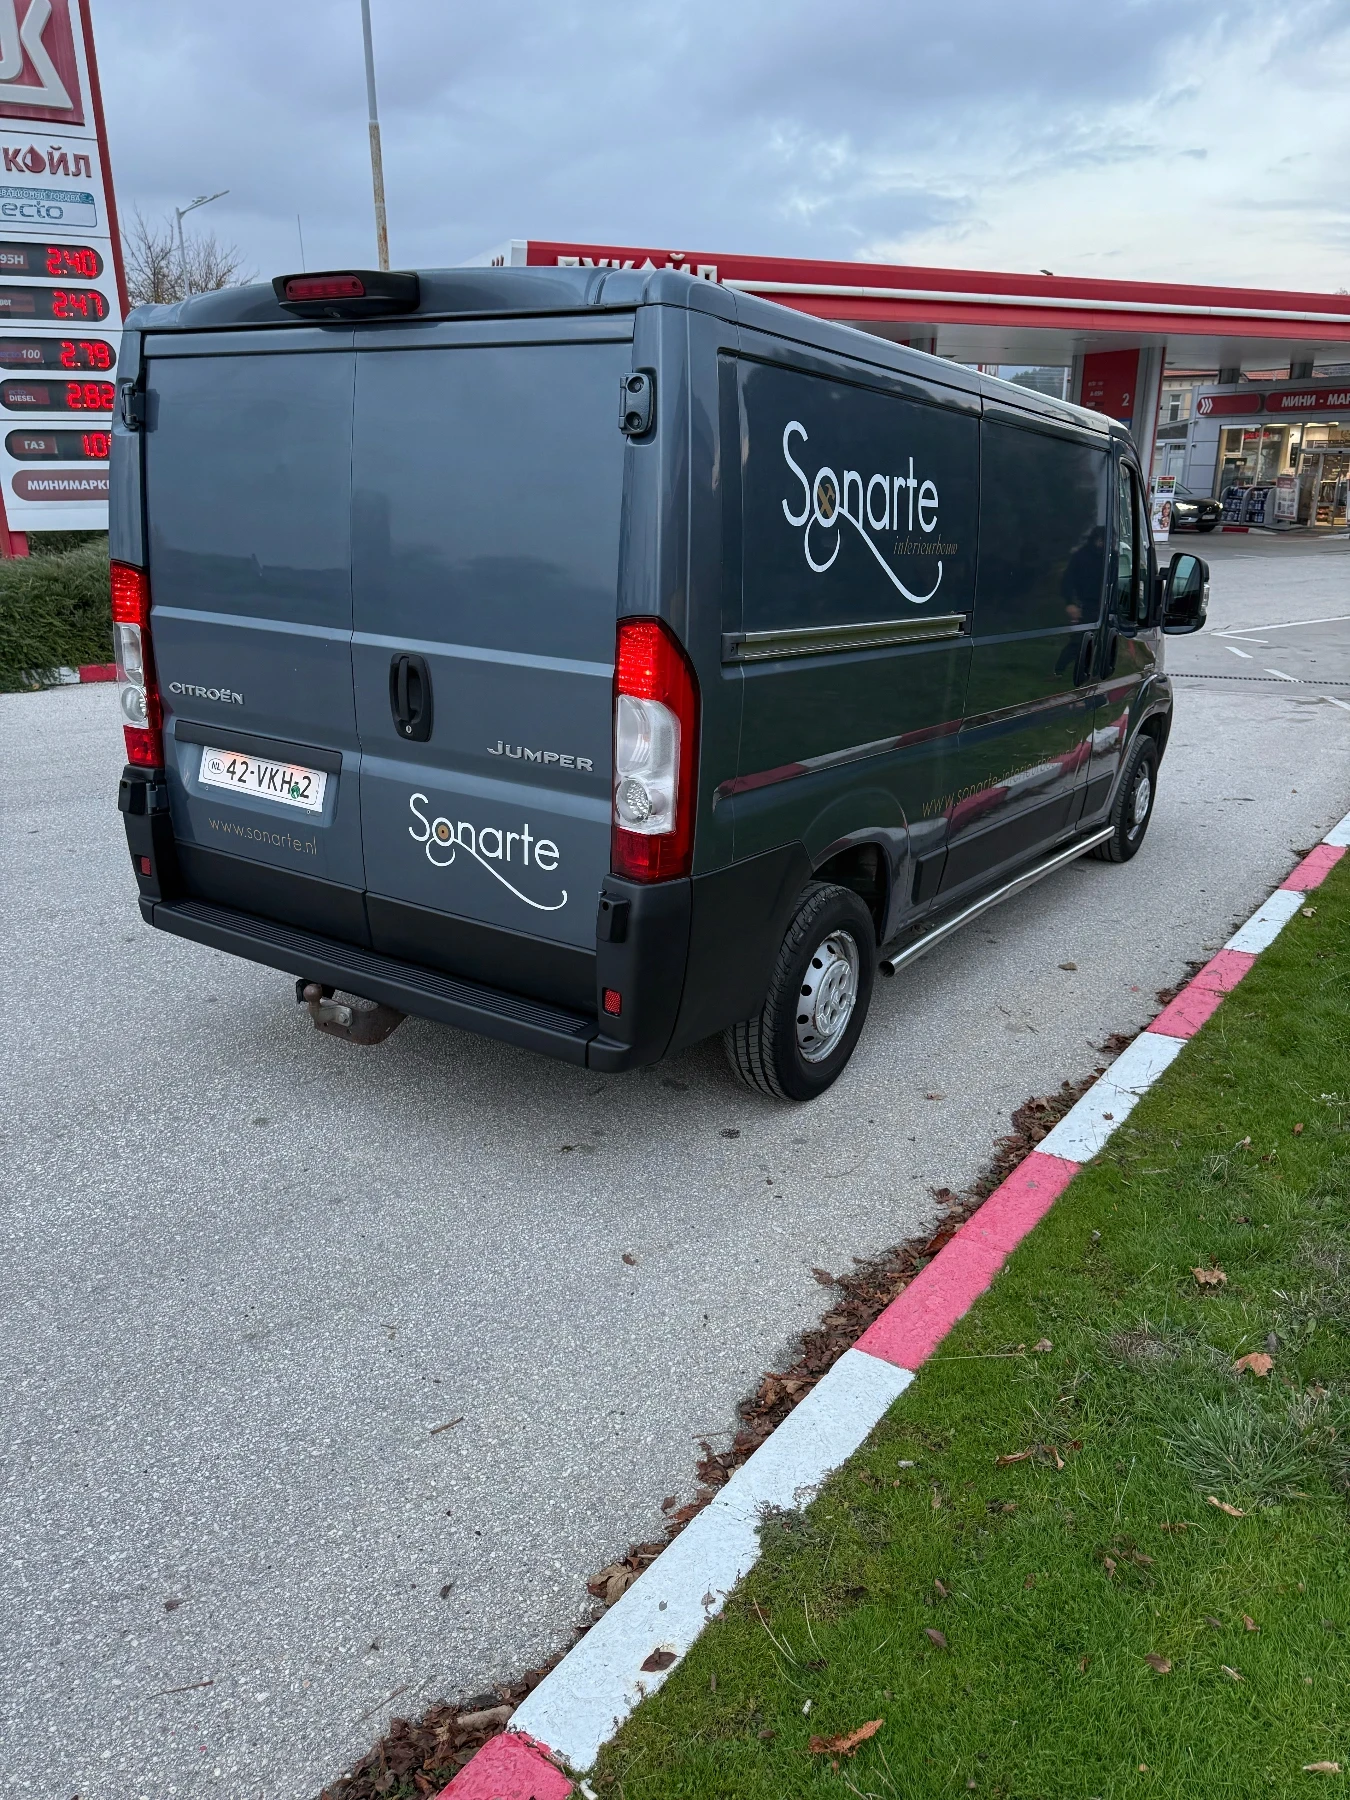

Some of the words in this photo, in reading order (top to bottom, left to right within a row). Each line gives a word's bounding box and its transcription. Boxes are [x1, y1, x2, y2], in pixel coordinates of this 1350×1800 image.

[1, 201, 64, 219] ecto
[46, 247, 97, 277] 2.40
[53, 291, 104, 317] 2.47
[22, 349, 40, 359] 100
[60, 341, 110, 369] 2.79
[67, 383, 115, 409] 2.82
[1122, 393, 1130, 407] 2
[1281, 395, 1316, 408] МИНИ
[24, 440, 45, 449] ГАЗ
[27, 480, 109, 491] МИНИМАРК
[781, 420, 939, 566] Sonarte
[893, 534, 958, 555] interieurbouw
[168, 681, 245, 705] CITROËN
[486, 740, 594, 772] JUMPER
[226, 758, 312, 799] 42-VKH-2
[208, 817, 317, 856] www.sonarte.nl
[408, 792, 563, 892] Sonarte
